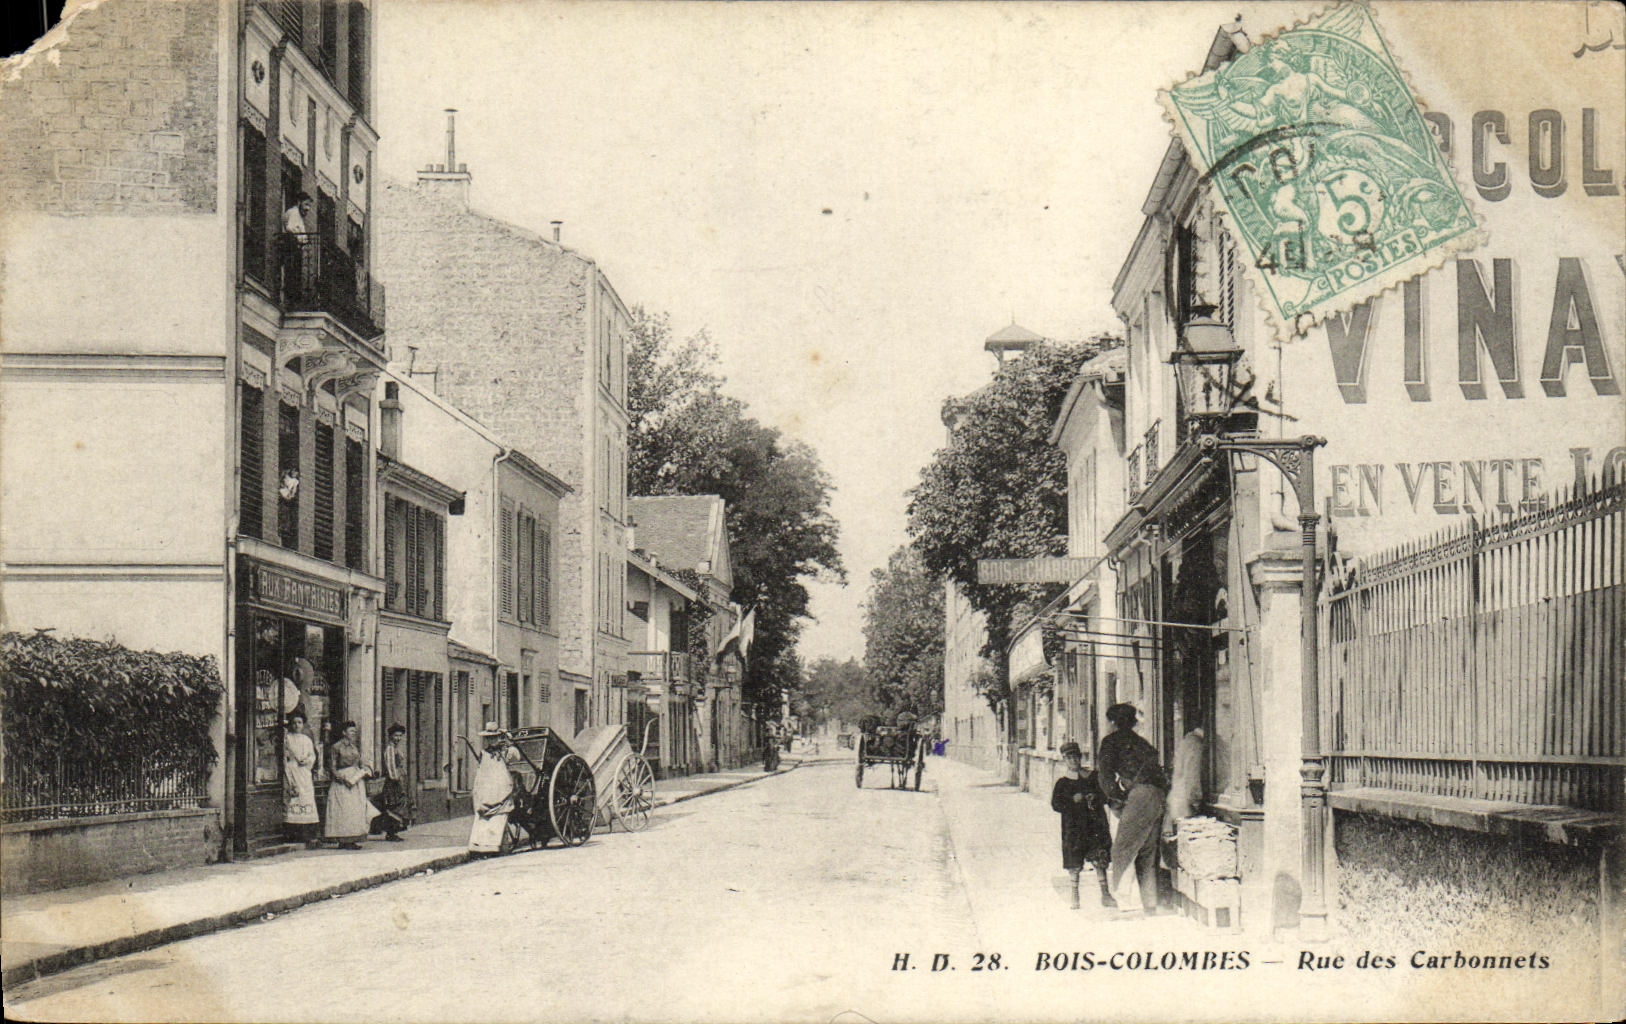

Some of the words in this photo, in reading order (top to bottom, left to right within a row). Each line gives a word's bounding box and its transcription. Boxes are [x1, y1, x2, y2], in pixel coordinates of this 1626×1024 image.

[1327, 232, 1417, 291] POSTES
[1325, 254, 1626, 405] VINA
[1328, 464, 1384, 517] EN
[1396, 458, 1546, 515] VENTE
[262, 571, 280, 599] AUX
[283, 577, 340, 613] FANTAISIES
[980, 560, 1011, 582] BOIS
[1012, 564, 1024, 580] et
[1026, 558, 1100, 581] CHARBONS
